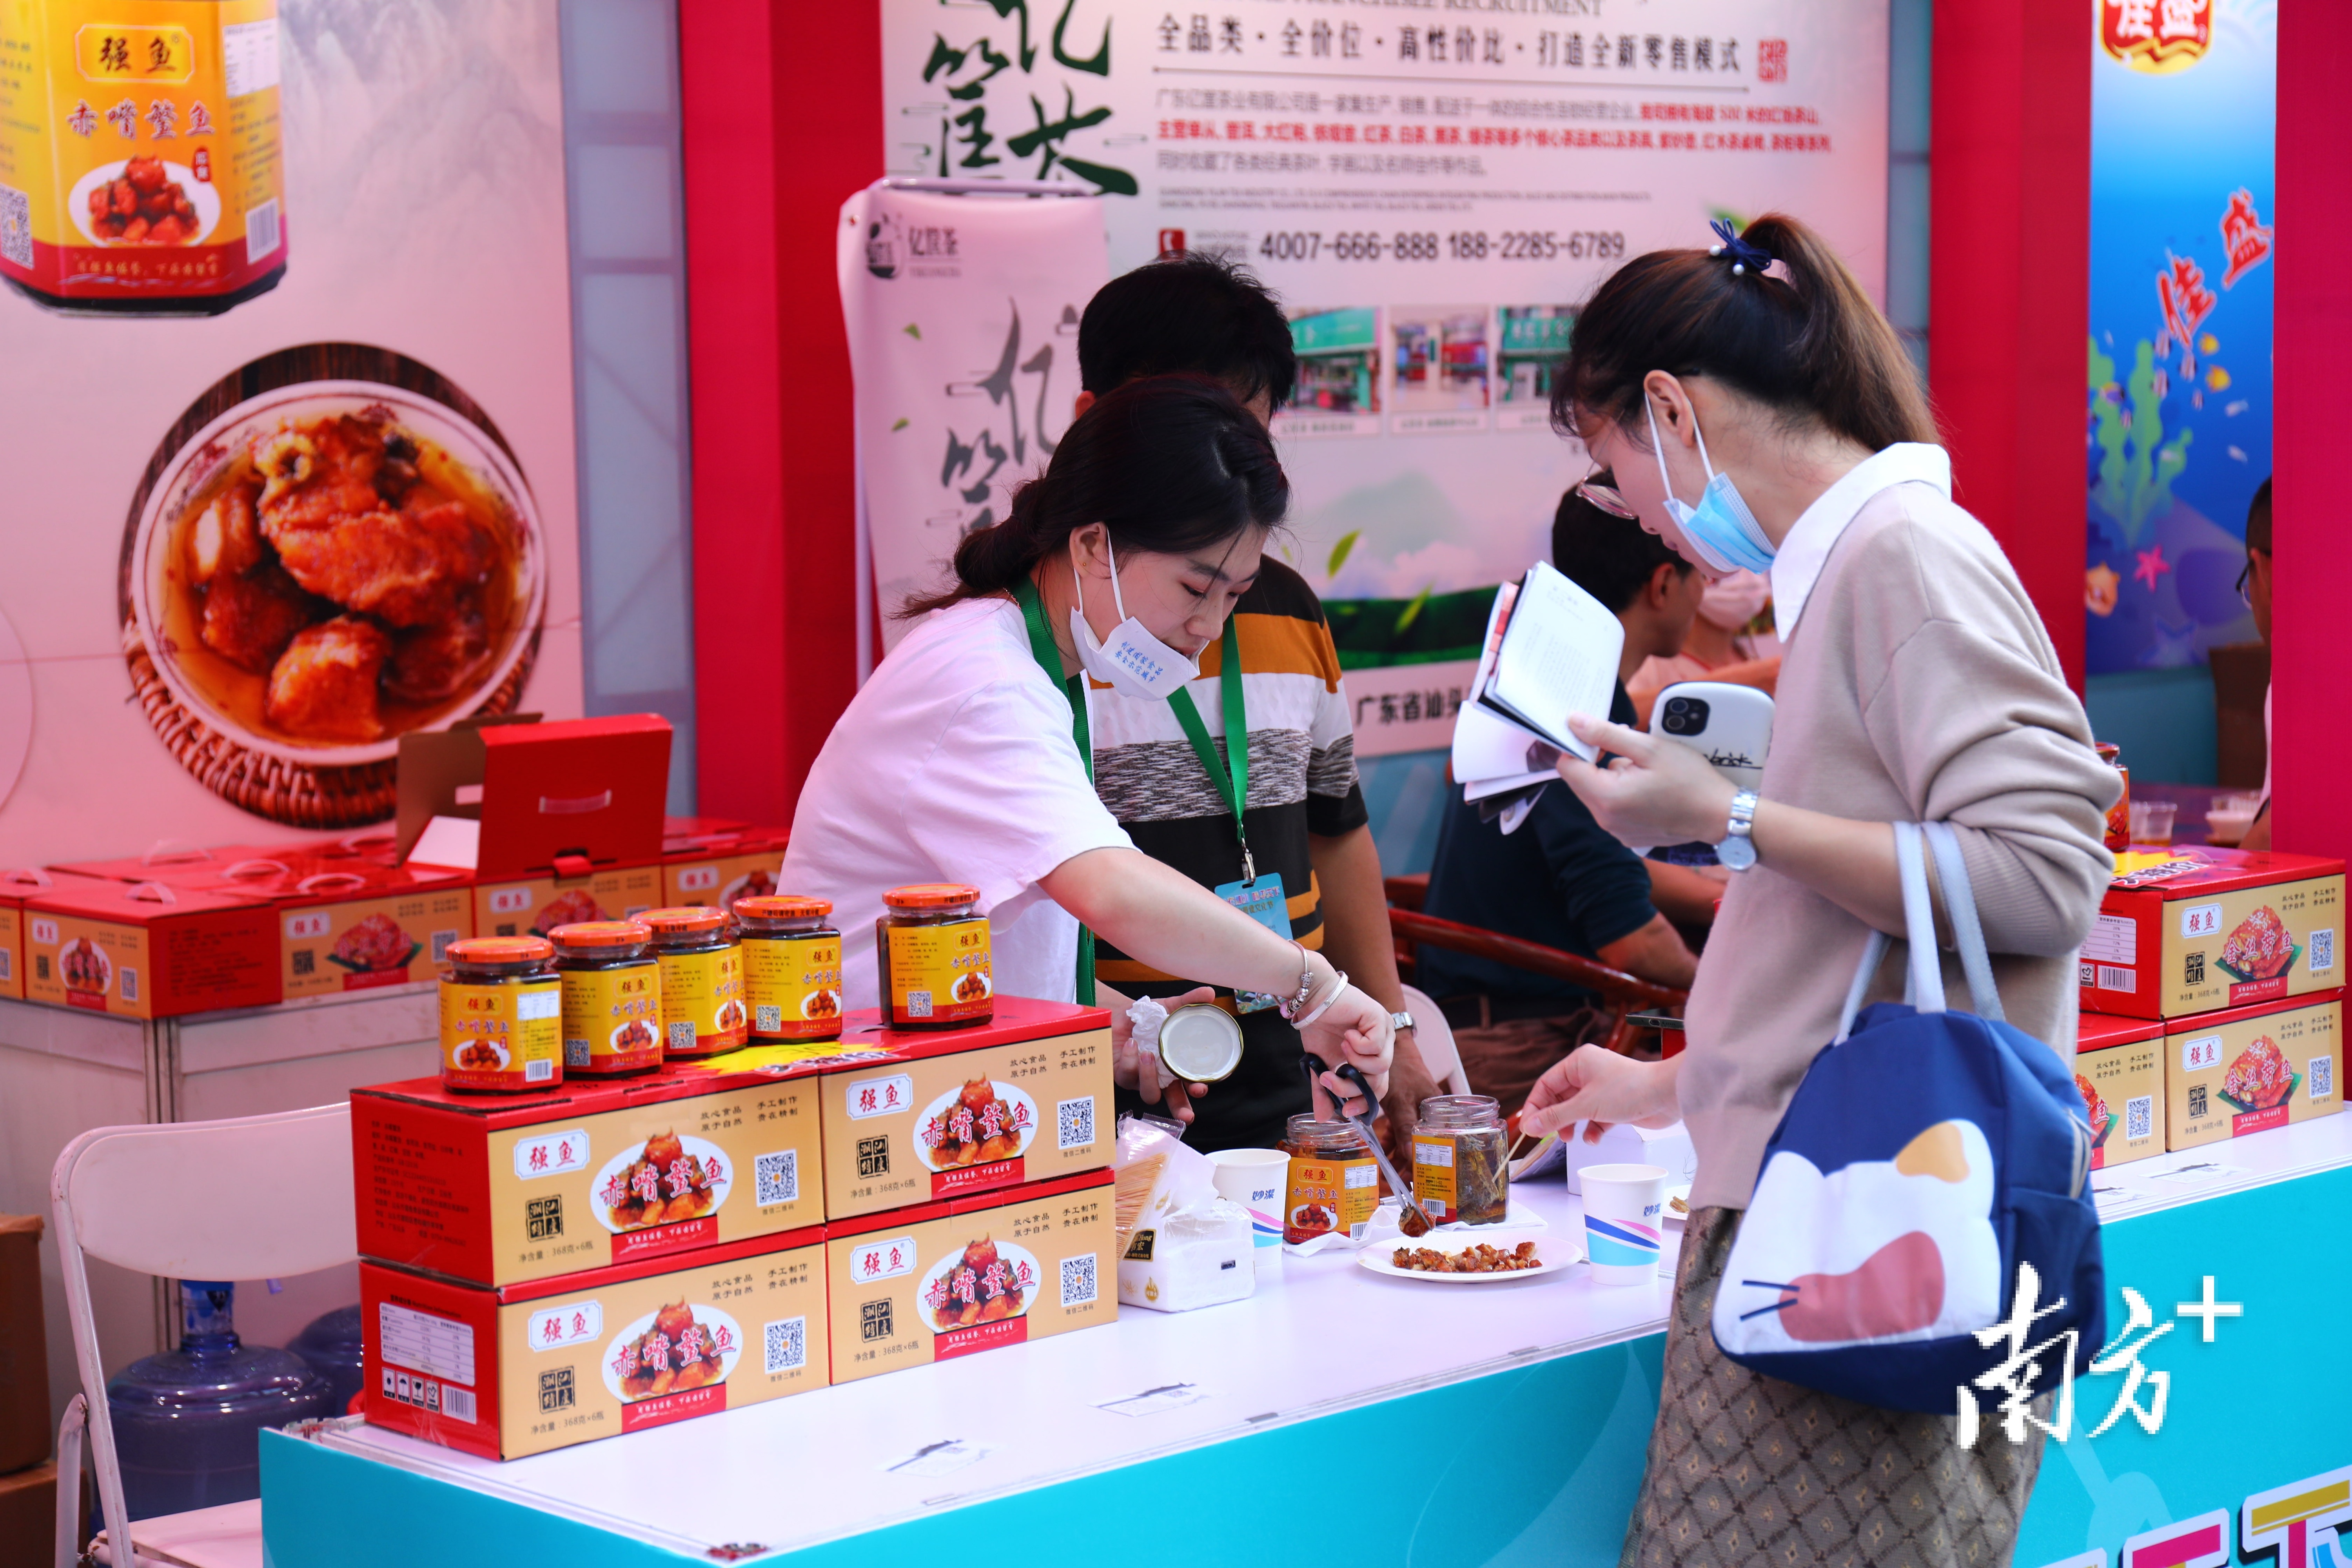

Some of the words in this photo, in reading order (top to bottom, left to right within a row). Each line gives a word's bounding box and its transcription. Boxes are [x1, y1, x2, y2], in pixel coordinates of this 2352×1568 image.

[99, 34, 176, 74] 强鱼
[66, 97, 215, 140] 赤嘴鳘鱼
[1260, 230, 1438, 261] 4007-666-888
[1450, 232, 1626, 262] 188-2285-6789
[1114, 650, 1156, 683] 安全示范城市
[1121, 641, 1163, 675] 创建国家食品
[1356, 685, 1472, 726] 广东省汕头
[2189, 910, 2215, 933] 强鱼
[960, 933, 980, 947] 强鱼
[2224, 928, 2294, 964] 金丝带鱼
[720, 959, 738, 973] 强鱼
[813, 949, 833, 963] 强鱼
[621, 979, 647, 994] 强鱼
[468, 997, 496, 1011] 强鱼
[1010, 1053, 1047, 1067] 放心食品
[1060, 1045, 1096, 1059] 手工制作
[2190, 1043, 2215, 1065] 强鱼
[1010, 1065, 1047, 1079] 原于自然
[1060, 1057, 1096, 1071] 贵在精制
[2225, 1057, 2294, 1095] 金丝带鱼
[700, 1106, 743, 1120] 放心食品
[757, 1096, 798, 1110] 手工制作
[859, 1084, 900, 1111] 强鱼
[701, 1117, 743, 1132] 原于自然
[757, 1107, 798, 1122] 贵在精制
[921, 1101, 1033, 1149] 赤嘴鳘鱼
[529, 1140, 575, 1171] 强鱼
[1063, 1147, 1092, 1158] 微信二维码
[599, 1156, 726, 1208] 赤嘴鳘鱼
[1304, 1169, 1327, 1181] 强鱼
[850, 1178, 916, 1199] 净含量:368克×6瓶
[1252, 1188, 1275, 1201] 妙潔
[1293, 1186, 1338, 1200] 赤嘴鳘鱼
[1013, 1213, 1050, 1226] 放心食品
[1063, 1203, 1098, 1216] 手工制作
[1644, 1203, 1661, 1218] 妙潔
[1014, 1224, 1051, 1238] 原于自然
[1063, 1214, 1098, 1228] 贵在精制
[863, 1247, 904, 1274] 强鱼
[711, 1273, 753, 1290] 放心食品
[768, 1263, 808, 1278] 手工制作
[711, 1285, 753, 1301] 原于自然
[768, 1274, 808, 1289] 贵在精制
[924, 1260, 1036, 1310] 赤嘴鳘鱼
[1066, 1304, 1094, 1315] 微信二维码
[543, 1311, 589, 1343] 强鱼
[611, 1324, 737, 1378] 赤嘴鳘鱼
[853, 1341, 920, 1363] 净含量:368克×6瓶
